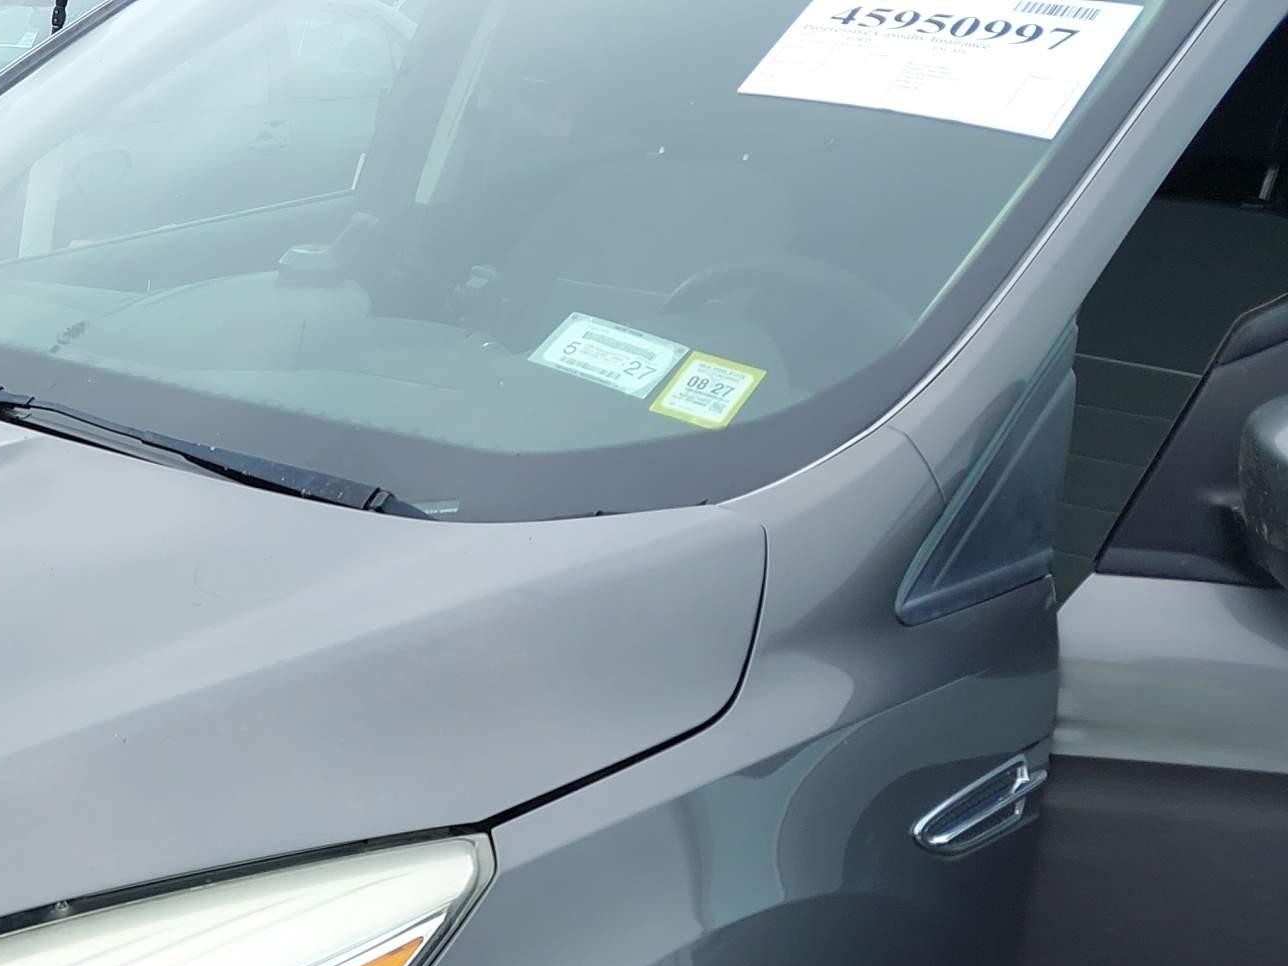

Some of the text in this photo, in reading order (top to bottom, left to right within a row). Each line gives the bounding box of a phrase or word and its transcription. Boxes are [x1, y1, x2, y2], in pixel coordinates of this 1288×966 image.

[830, 6, 1081, 50] 45950997
[563, 341, 581, 355] 5
[623, 360, 657, 380] 27
[687, 375, 710, 390] 08
[711, 382, 735, 398] 27
